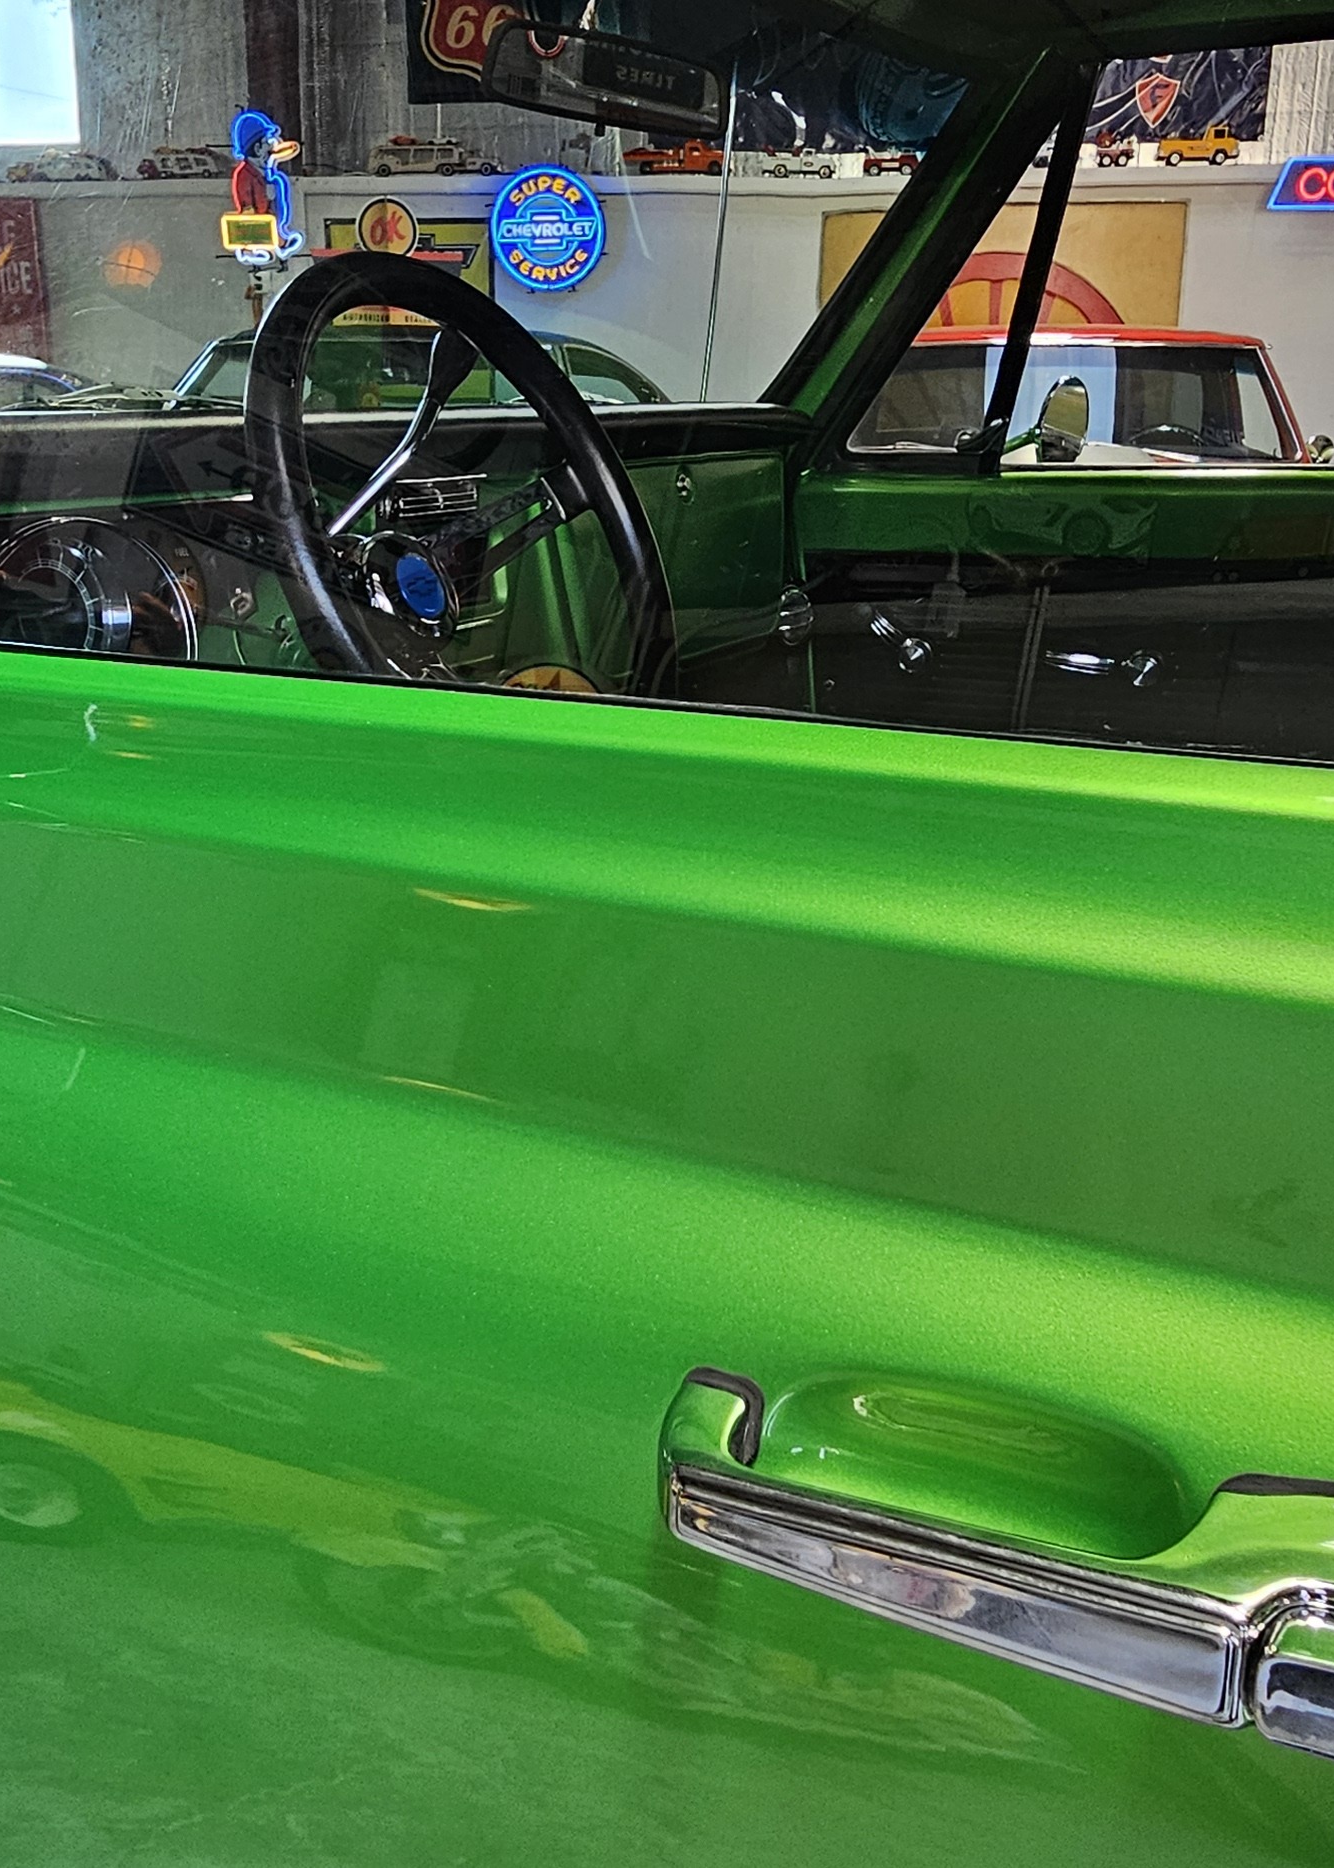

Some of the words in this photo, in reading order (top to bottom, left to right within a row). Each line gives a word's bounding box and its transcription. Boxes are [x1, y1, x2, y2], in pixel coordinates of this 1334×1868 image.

[509, 175, 582, 206] SUPER
[369, 210, 407, 246] OK
[502, 221, 593, 238] CHEVROLET
[509, 248, 588, 281] SERVICE
